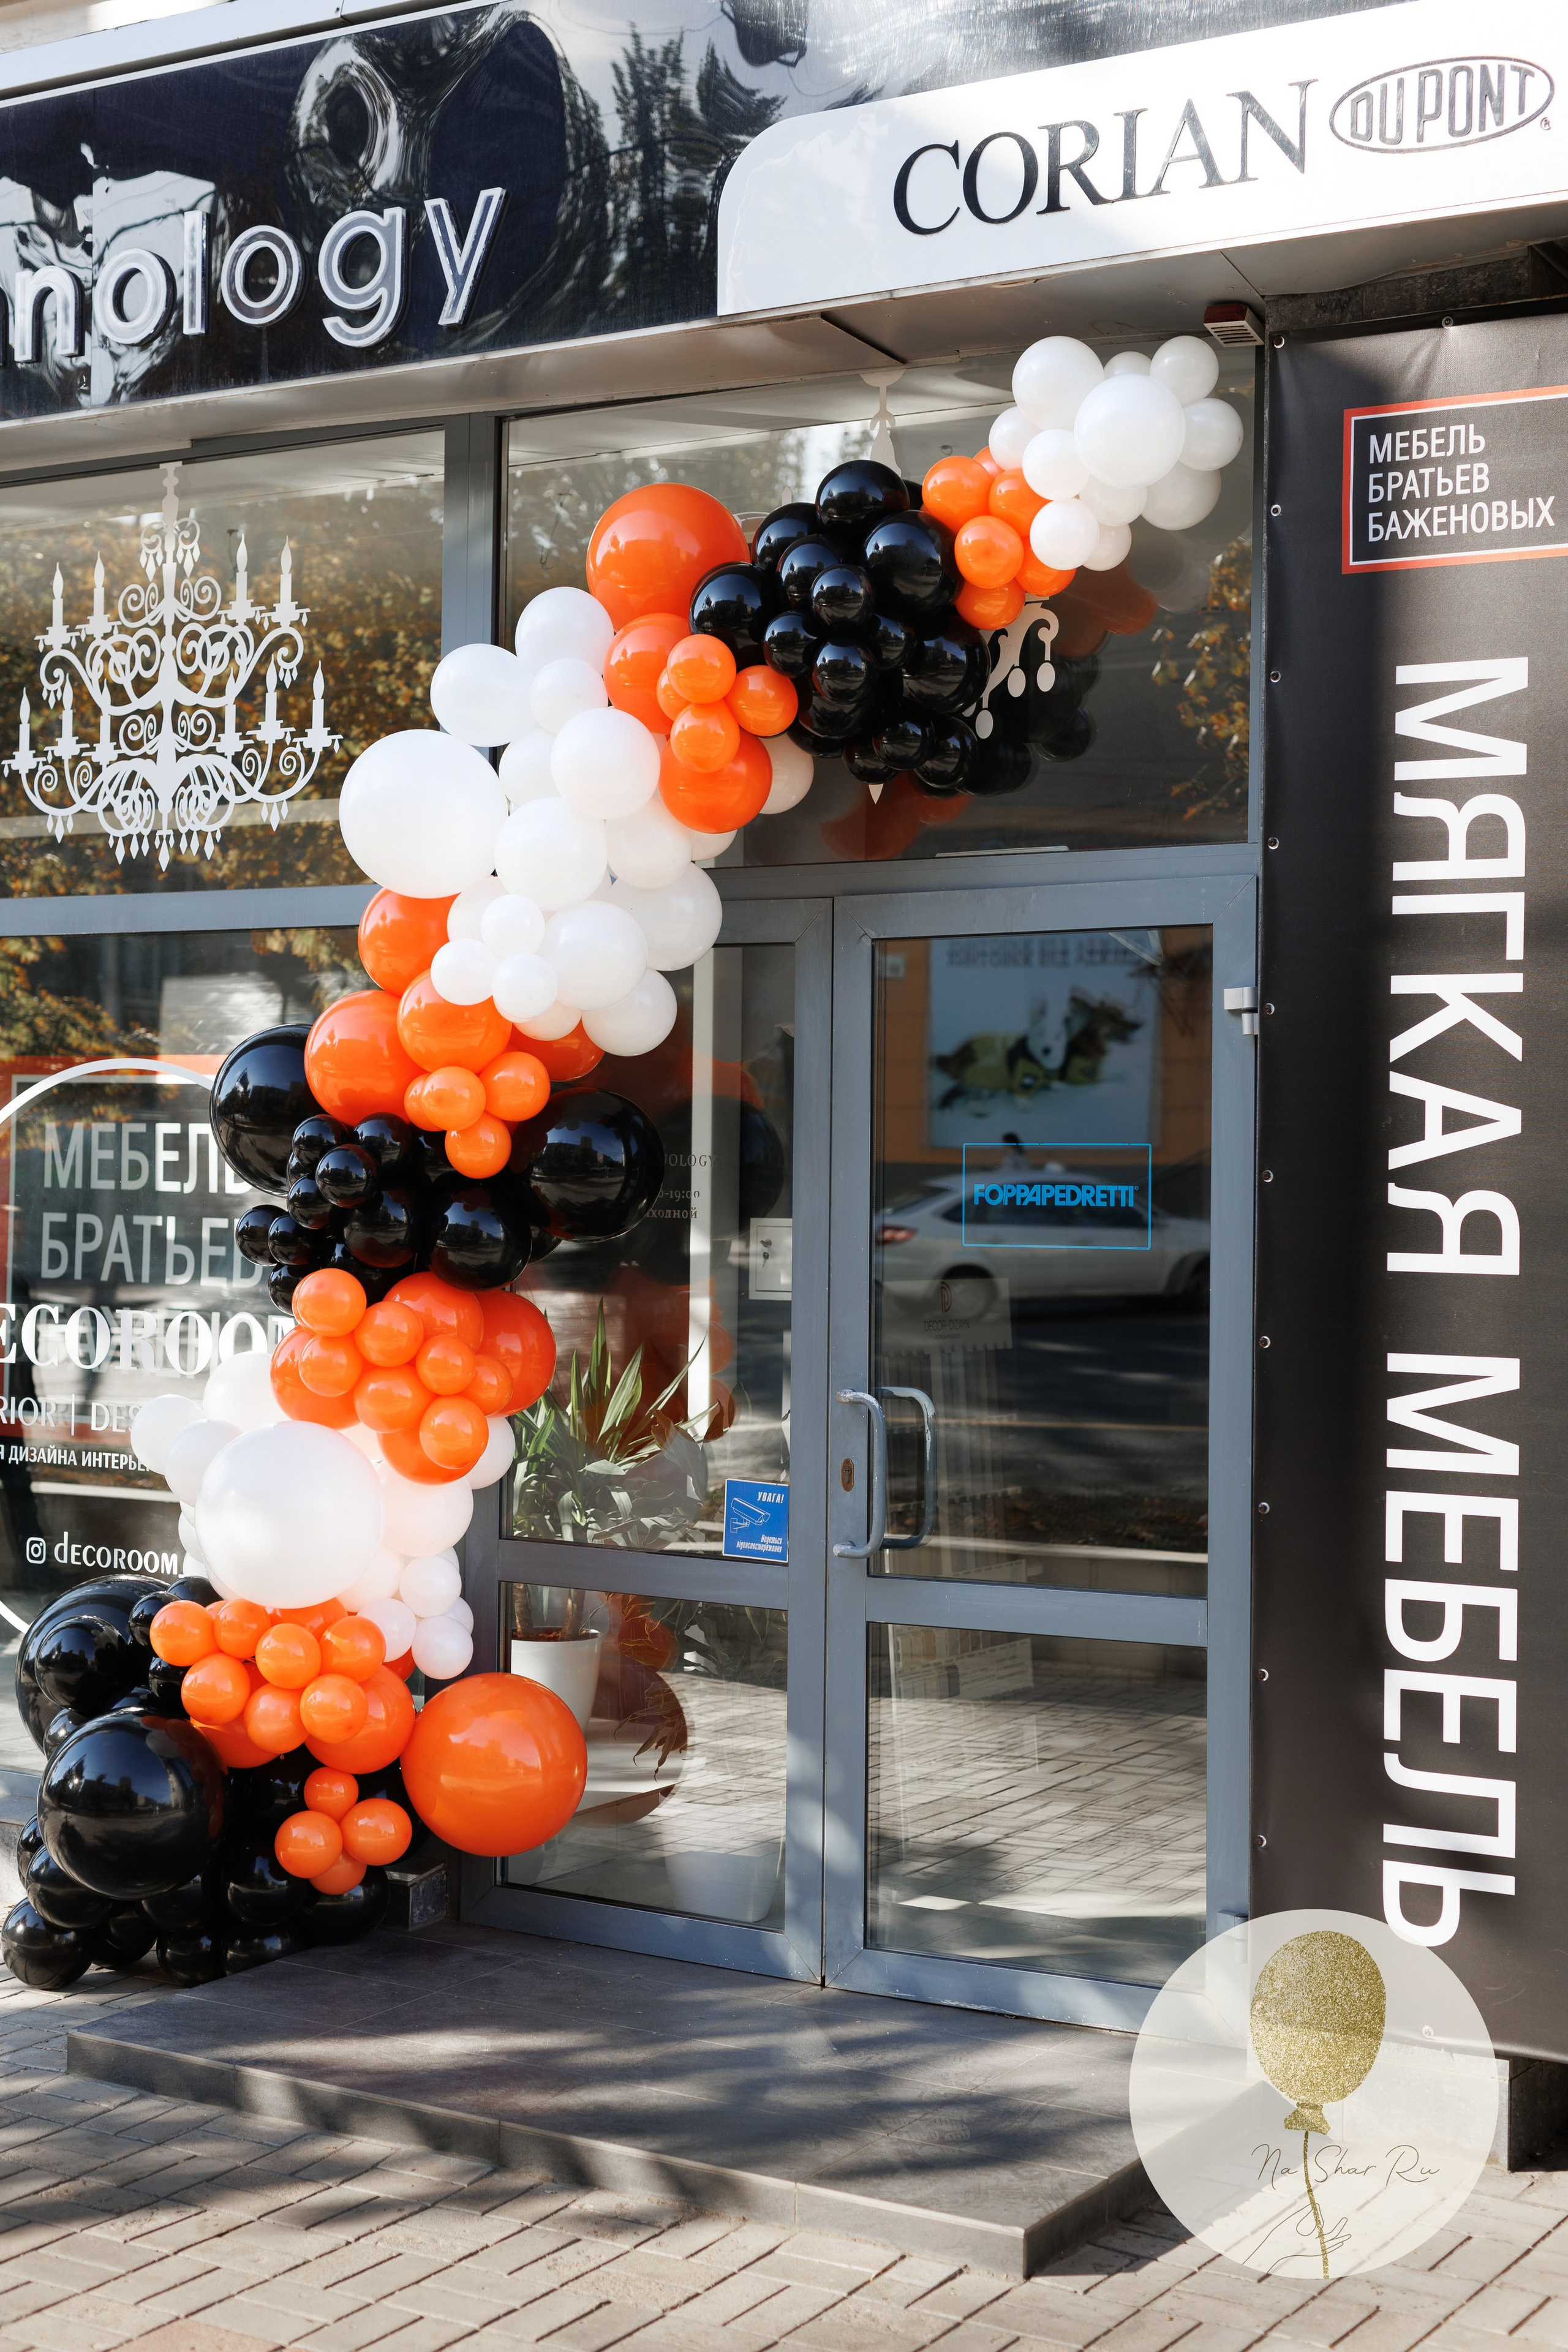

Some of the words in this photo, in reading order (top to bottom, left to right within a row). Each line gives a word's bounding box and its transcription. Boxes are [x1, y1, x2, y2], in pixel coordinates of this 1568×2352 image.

[893, 78, 1318, 235] CORIAN
[0, 186, 508, 364] nology
[1370, 423, 1485, 464] МЕБЕЛЬ
[1368, 462, 1490, 503] БРАТЬЕВ
[1368, 496, 1556, 542] БАЖЕНОВЫХ
[1386, 657, 1529, 1275] МЯГКАЯ
[9, 1444, 77, 1466] ДИЗАЙНА
[757, 1491, 784, 1504] УВАГА!
[1382, 1352, 1520, 1947] МЕБЕЛЬ
